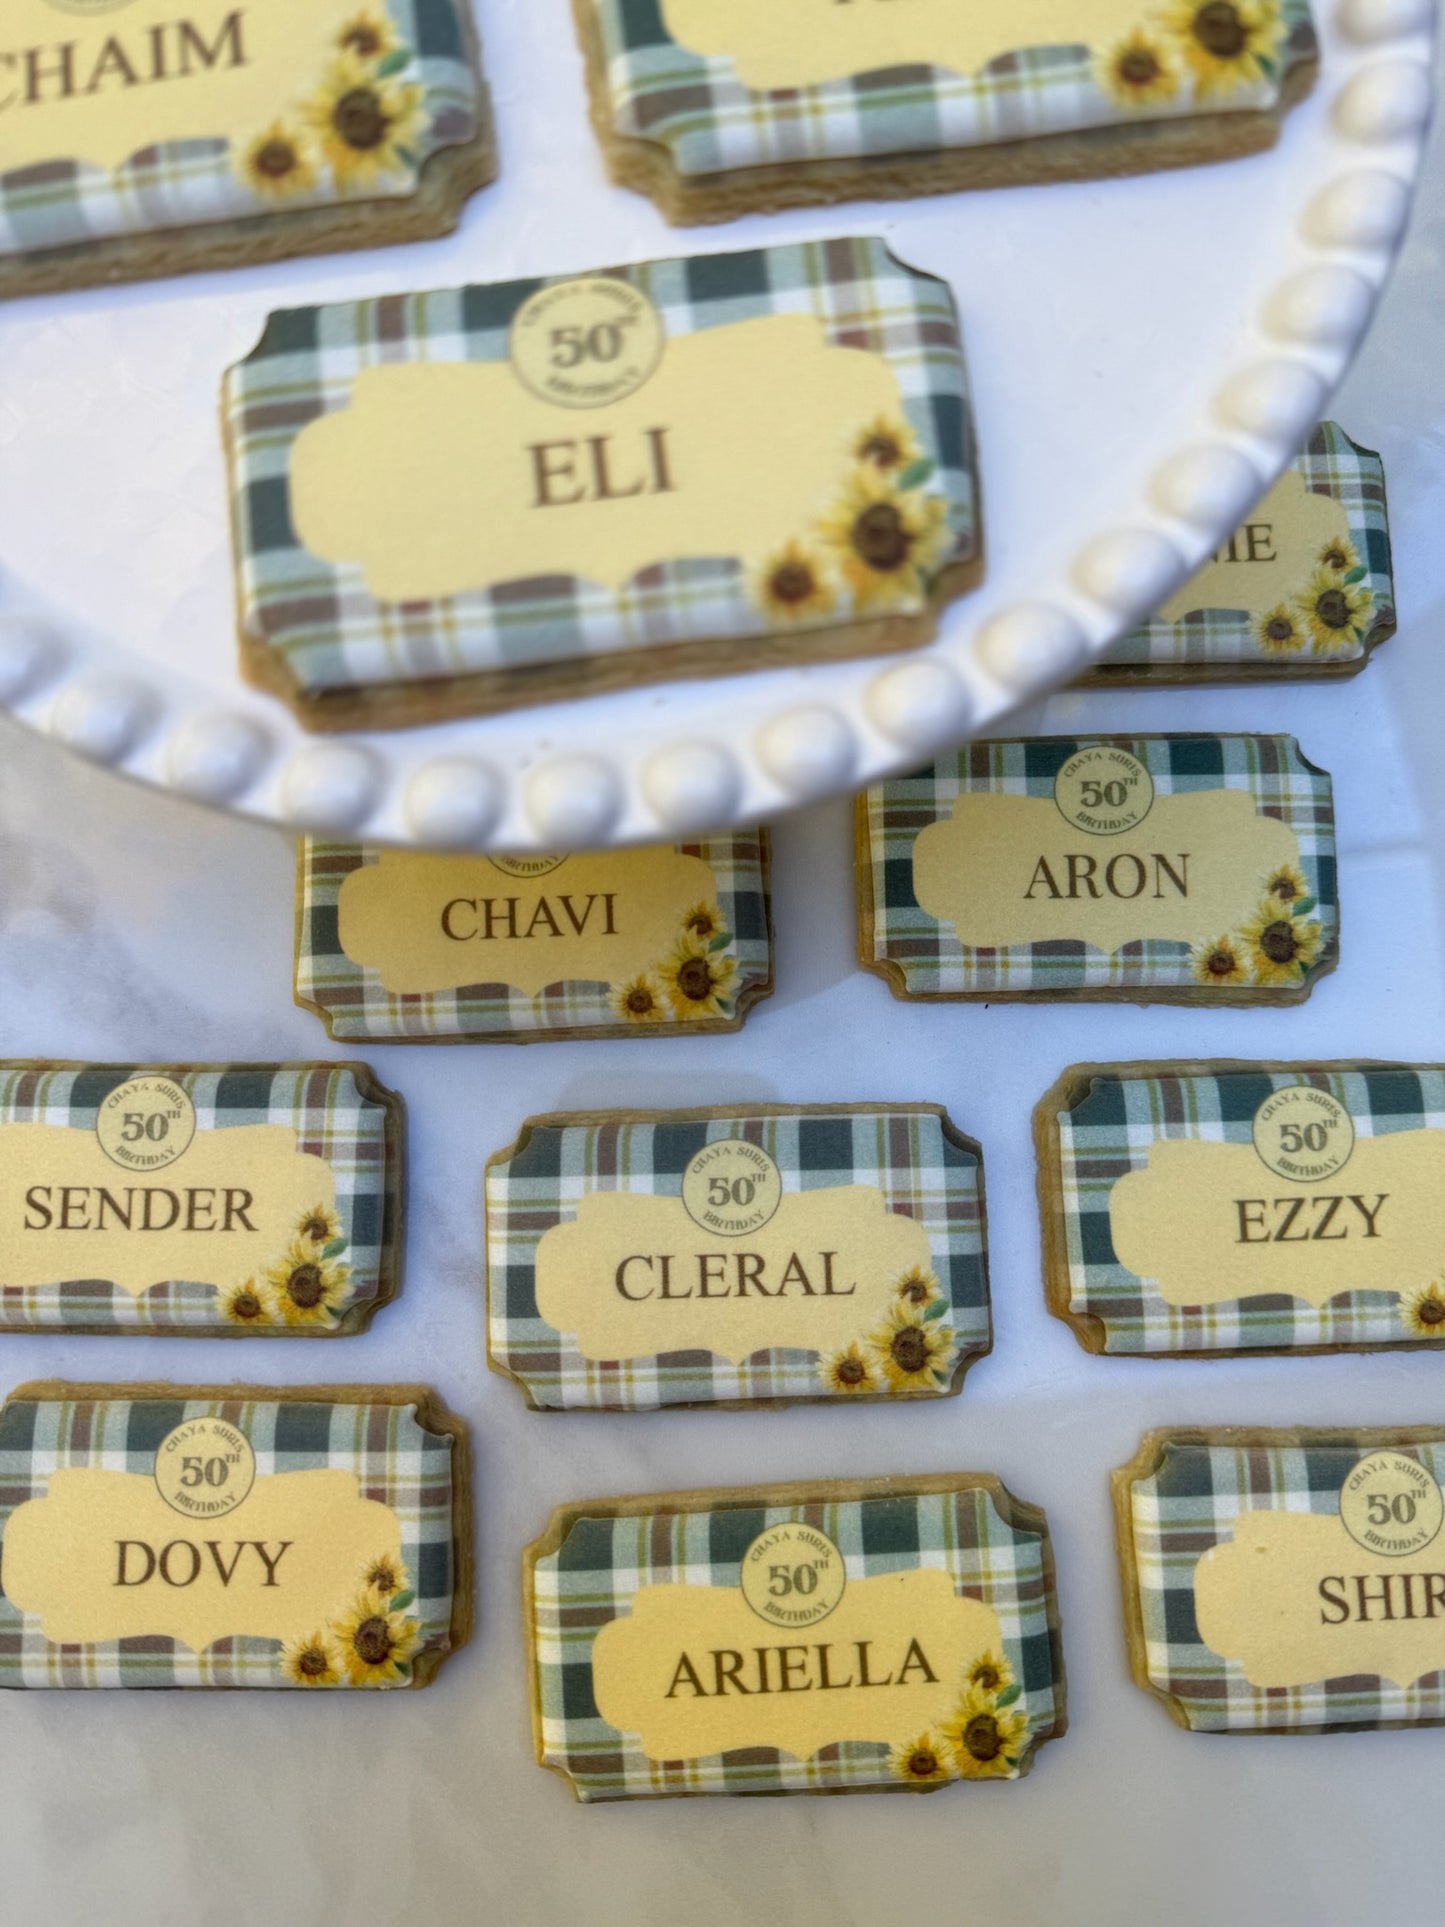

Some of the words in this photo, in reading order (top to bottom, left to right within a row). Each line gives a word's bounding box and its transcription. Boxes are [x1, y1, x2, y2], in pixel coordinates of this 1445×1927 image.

[525, 426, 674, 508] ELI
[1064, 752, 1103, 778] CHAYA
[1076, 811, 1138, 829] BIRTHDAY
[1022, 852, 1192, 900] ARON
[441, 893, 620, 942] CHAVI
[108, 1084, 148, 1108] CHAYA
[1261, 1093, 1300, 1121] CHAYA
[115, 1145, 176, 1165] BIRTHDAY
[692, 1147, 731, 1174] CHAYA
[1276, 1154, 1340, 1175] BIRTHDAY
[24, 1185, 258, 1232] SENDER
[703, 1210, 765, 1230] BIRTHDAY
[1234, 1193, 1389, 1244] EZZY
[615, 1251, 856, 1302] CLERAL
[165, 1423, 207, 1452] CHAYA
[1349, 1460, 1388, 1491] CHAYA
[174, 1492, 237, 1512] BIRTHDAY
[751, 1531, 790, 1561] CHAYA
[1364, 1528, 1428, 1550] BIRTHDAY
[114, 1539, 293, 1587] DOVY
[764, 1599, 828, 1621] BIRTHDAY
[664, 1638, 940, 1699] ARIELLA
